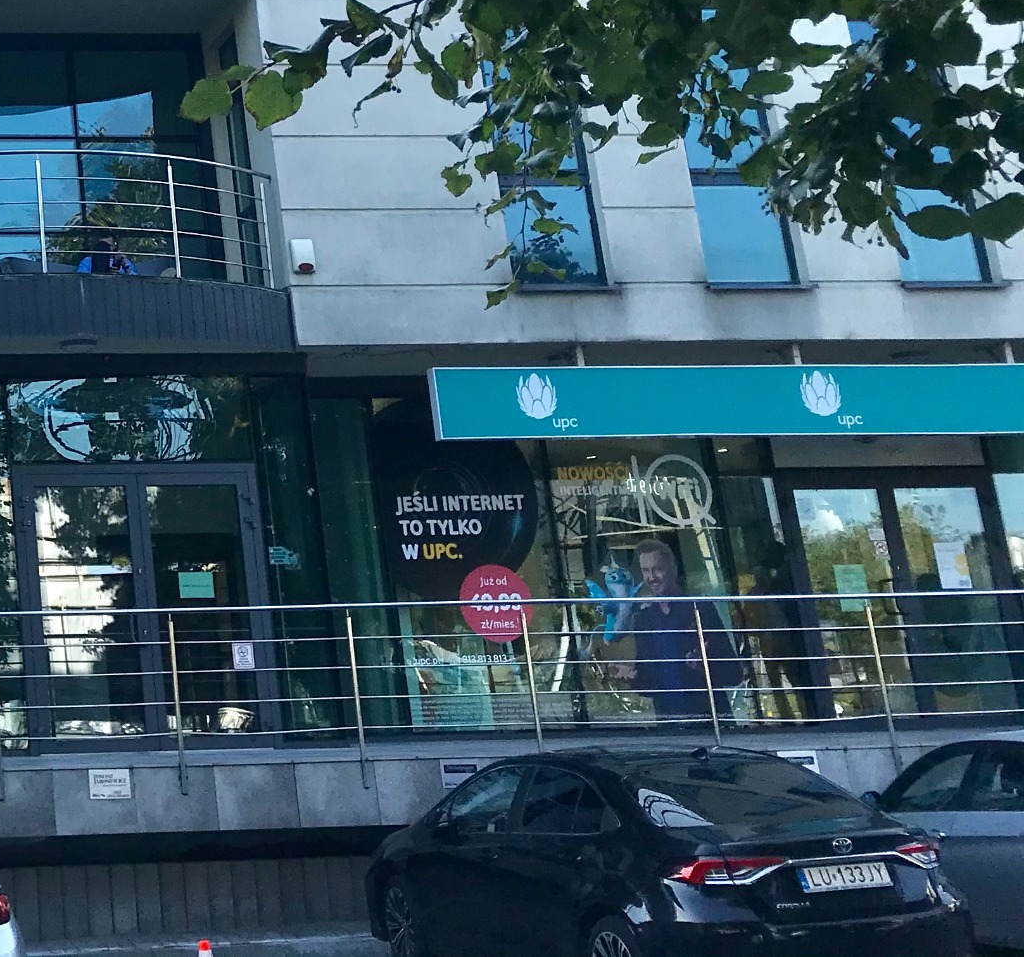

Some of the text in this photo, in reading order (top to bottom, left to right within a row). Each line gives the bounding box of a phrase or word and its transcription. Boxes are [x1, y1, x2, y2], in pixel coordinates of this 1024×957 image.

[552, 418, 578, 432] upc
[837, 415, 864, 429] upc
[396, 491, 524, 516] JEŚLI INTERNET
[399, 518, 482, 536] TO TYLKO
[401, 543, 463, 560] W UPC.
[480, 575, 507, 588] Już od
[808, 863, 884, 887] LU 133JY
